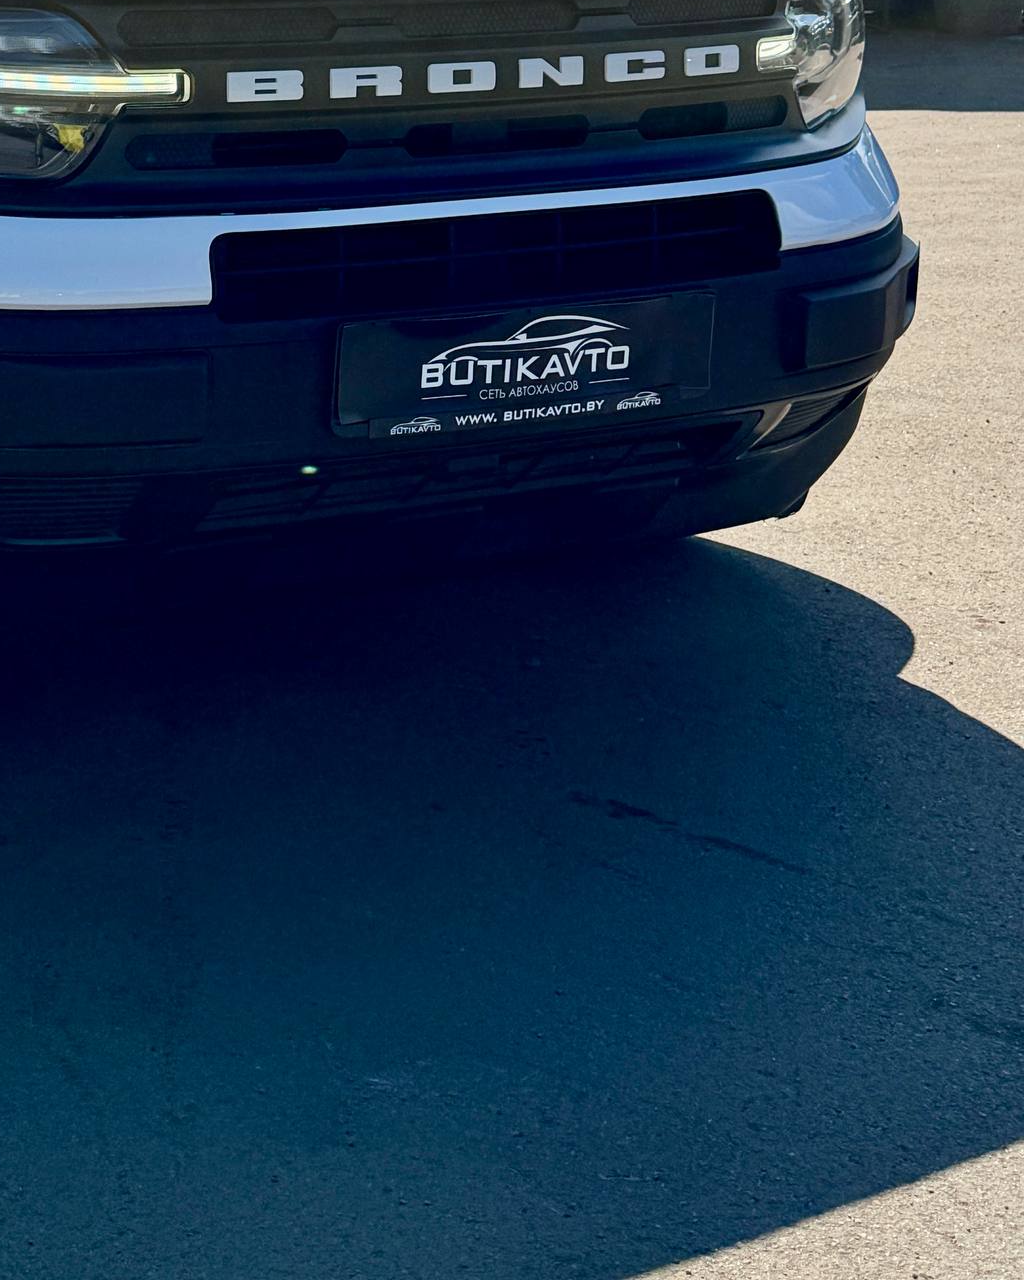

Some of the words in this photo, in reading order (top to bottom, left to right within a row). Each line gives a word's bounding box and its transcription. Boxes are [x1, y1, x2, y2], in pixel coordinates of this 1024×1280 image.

[226, 44, 740, 103] BRONCO
[421, 346, 630, 389] BUTIKAVTO
[479, 388, 506, 400] СЕТЬ
[509, 381, 579, 398] АВТОХАУСОВ
[503, 399, 605, 421] BUTIKAVTO.BY
[617, 398, 661, 411] BUTIKAVTO
[390, 424, 441, 435] BUTIKAVTO
